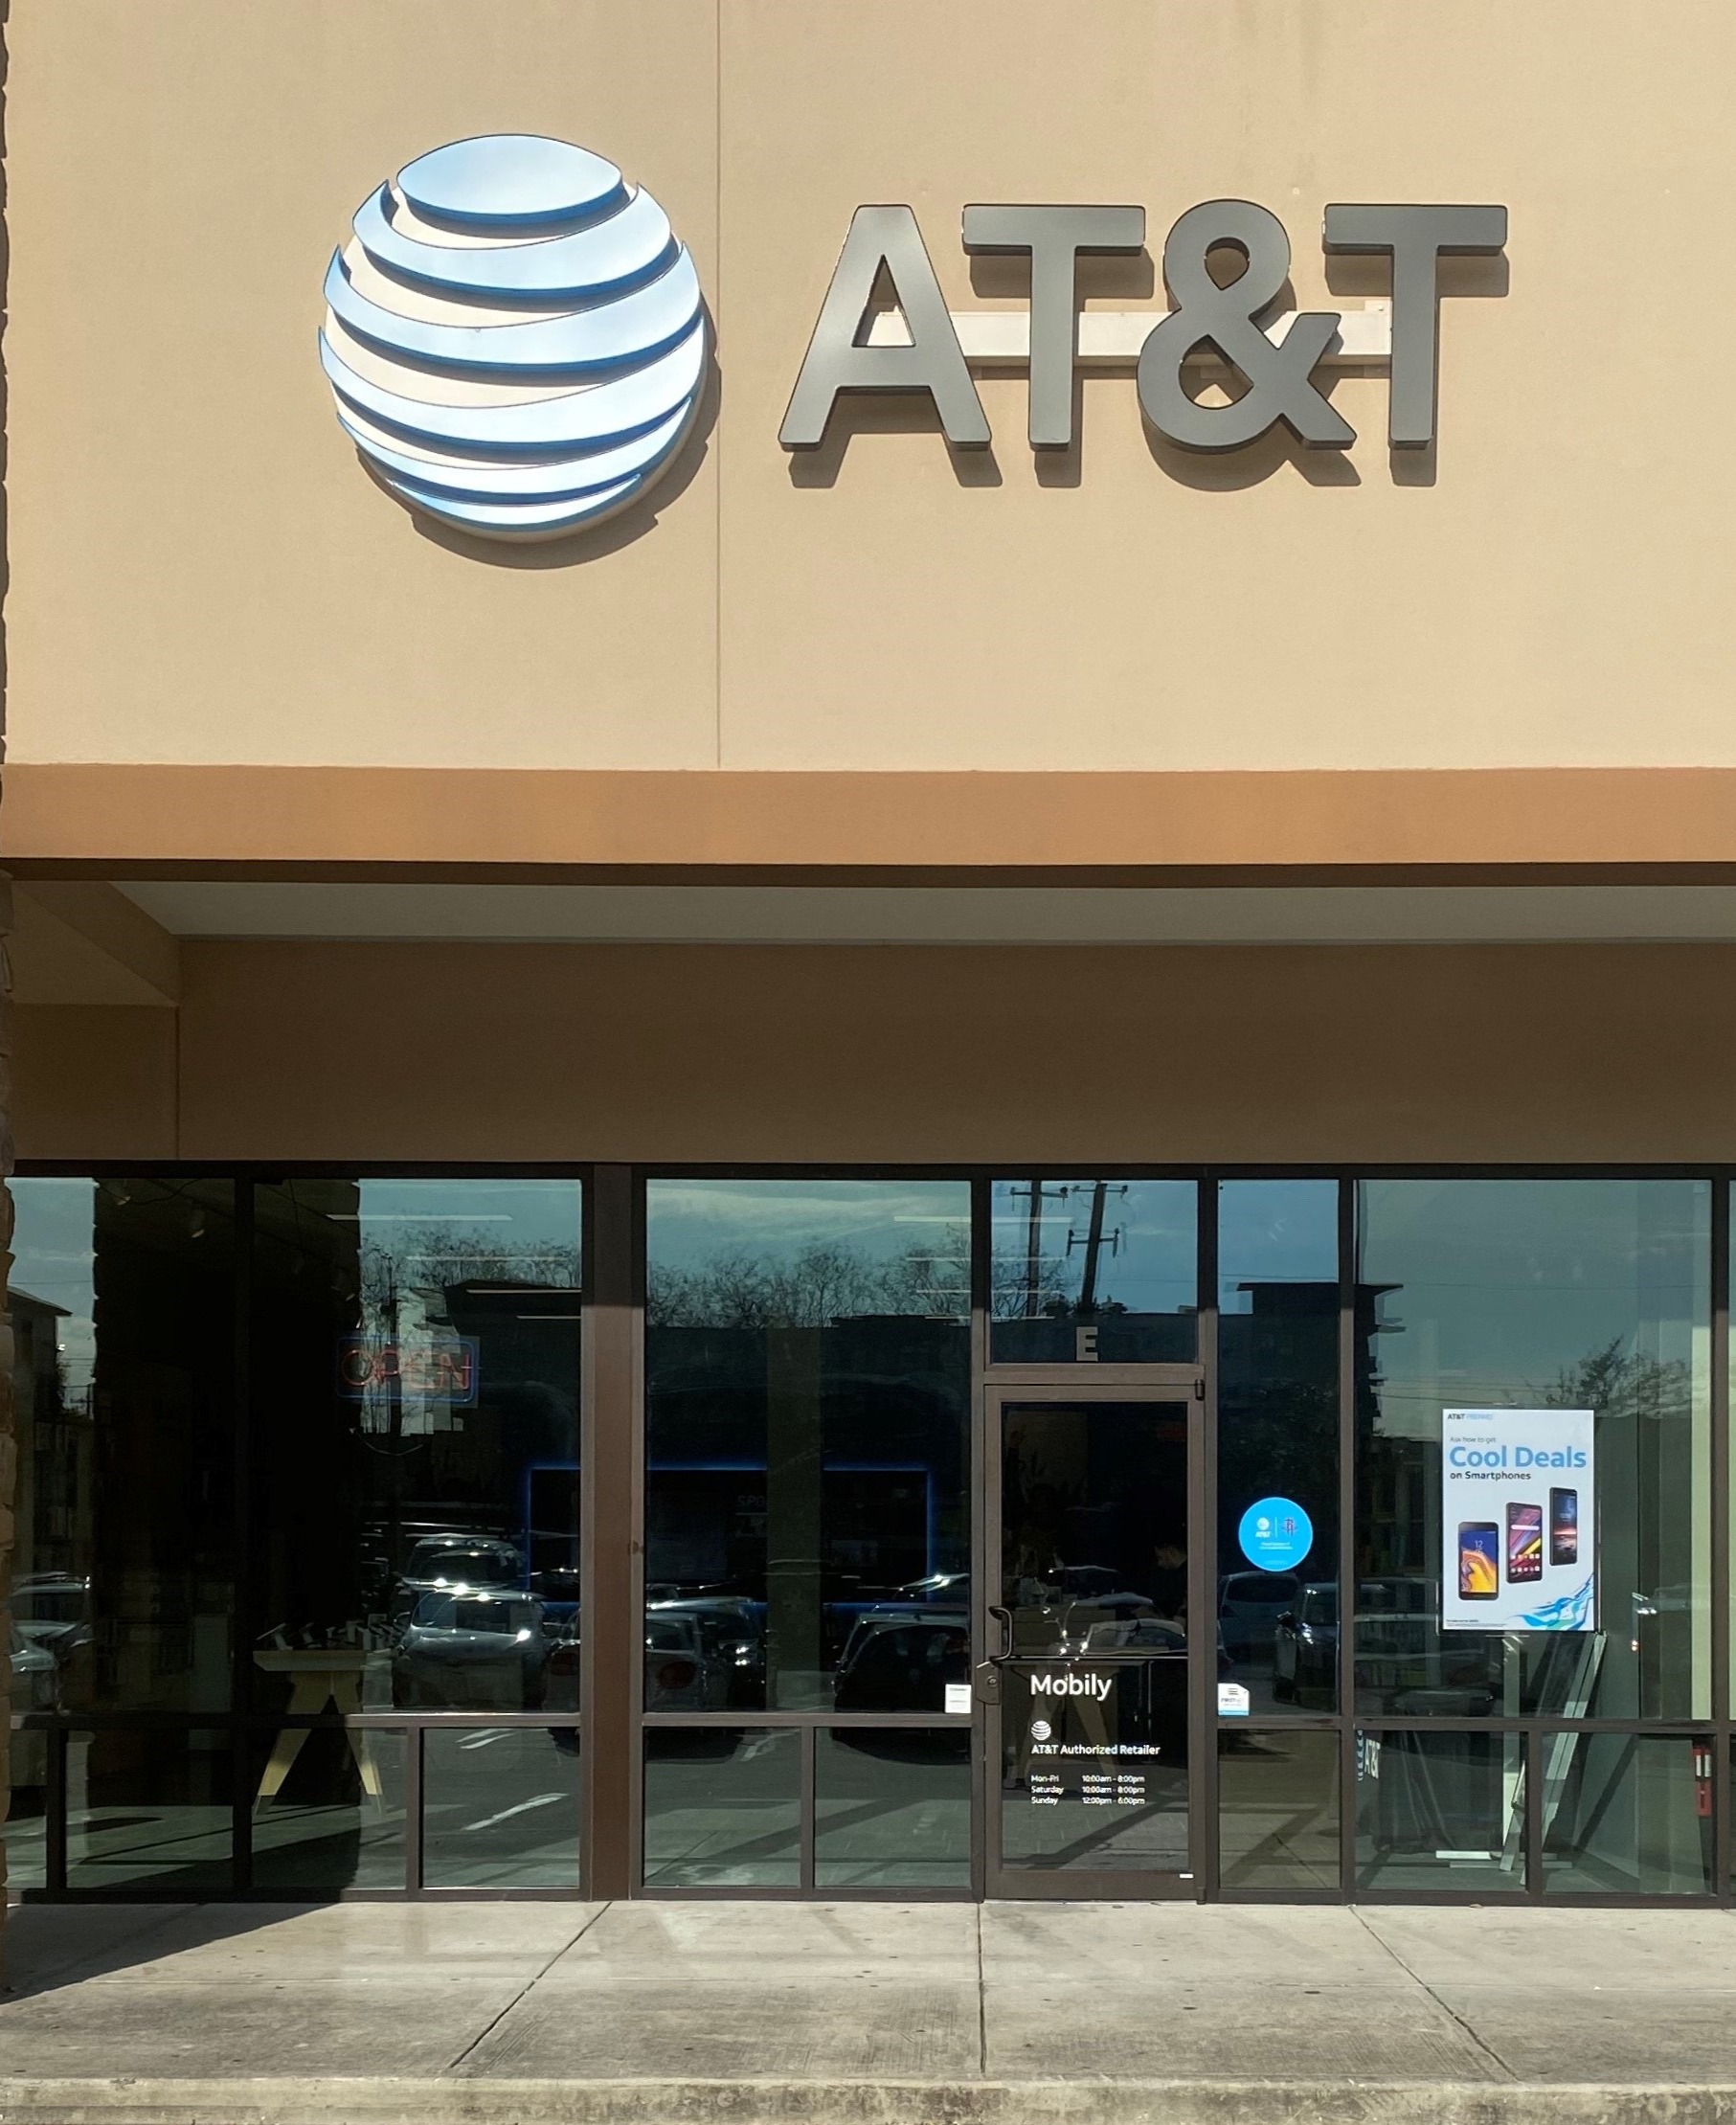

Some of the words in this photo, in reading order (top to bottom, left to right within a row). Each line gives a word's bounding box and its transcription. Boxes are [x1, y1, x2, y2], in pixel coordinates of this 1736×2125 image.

[778, 199, 1508, 448] AT&T
[1076, 1326, 1098, 1361] E
[342, 1349, 469, 1390] OPEN
[1449, 1446, 1507, 1468] Cool
[1515, 1446, 1587, 1468] Deals
[1465, 1471, 1531, 1481] Smartphones
[1030, 1673, 1113, 1701] Mobily
[1031, 1744, 1059, 1754] AT&T
[1060, 1744, 1118, 1754] Authorized
[1119, 1744, 1161, 1754] Retailer
[1364, 1738, 1381, 1779] AT&T
[1031, 1785, 1064, 1795] Saturday
[1082, 1785, 1112, 1794] 10:00am
[1117, 1785, 1145, 1795] 8:00pm
[1117, 1775, 1145, 1784] 8:00pm
[1031, 1797, 1059, 1806] Sunday
[1082, 1797, 1112, 1805] 12:00pm
